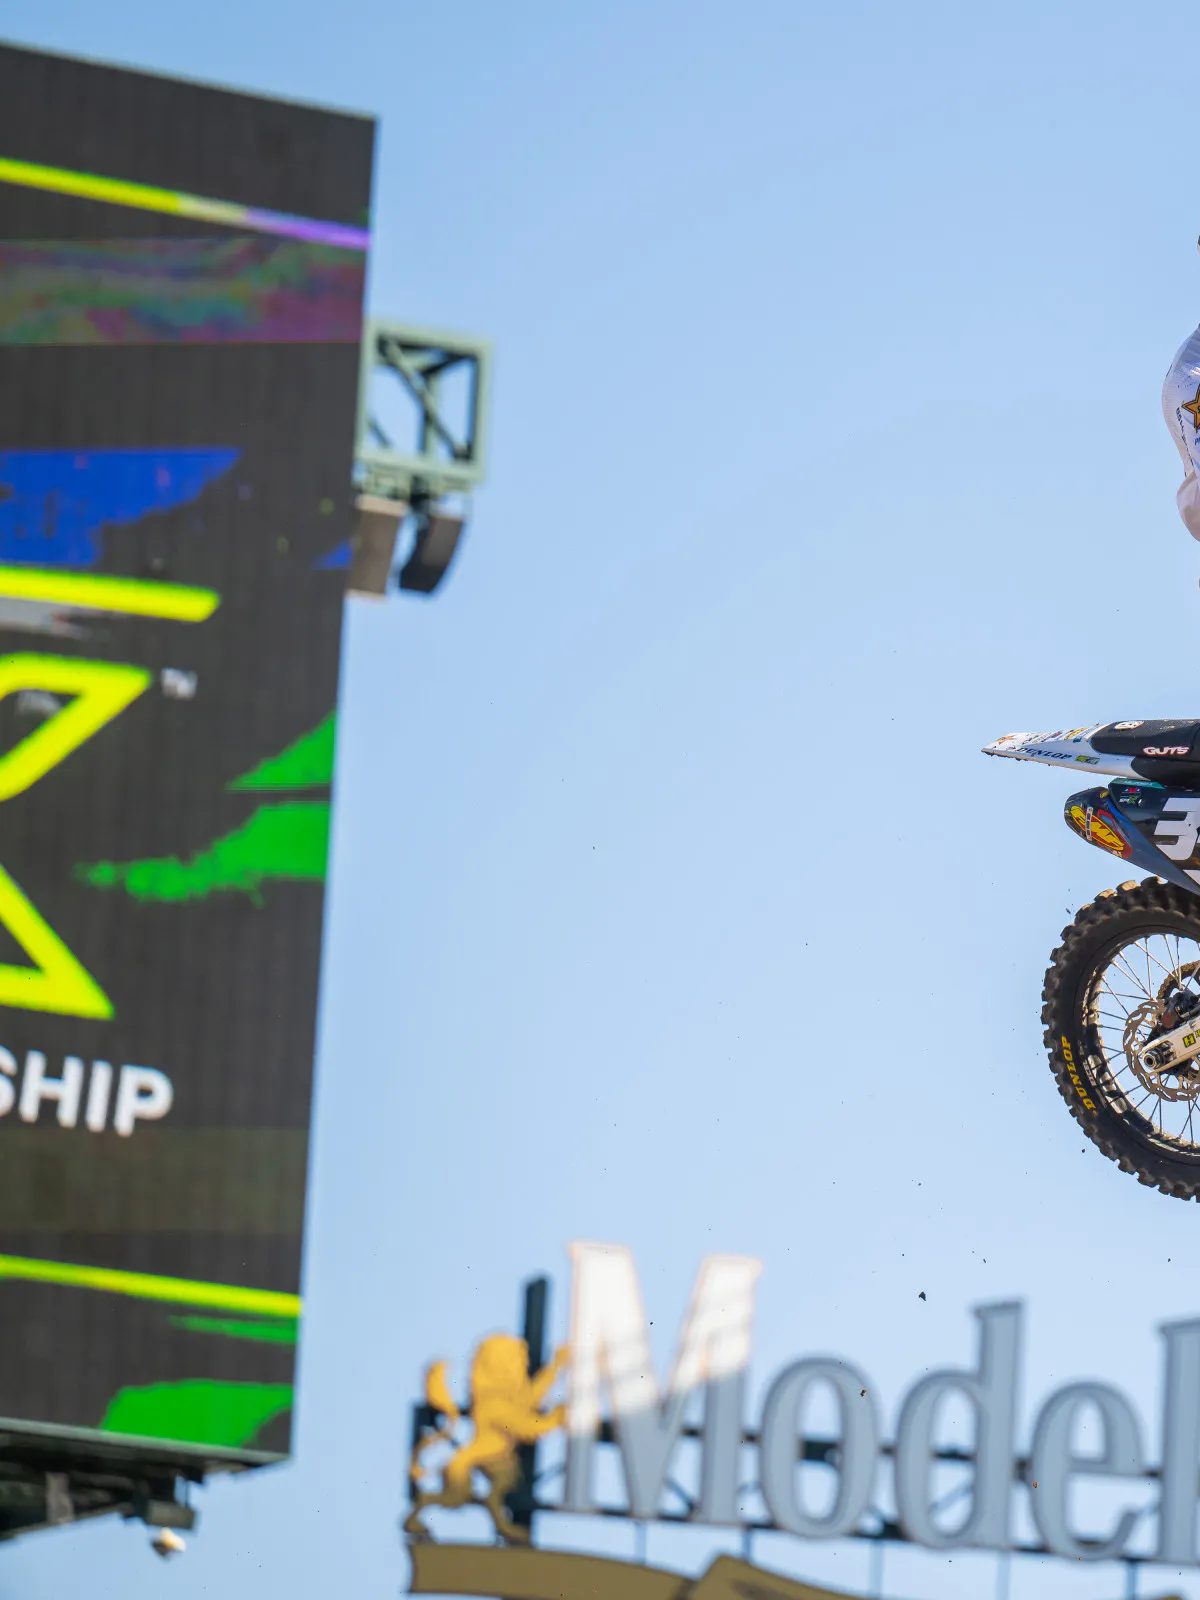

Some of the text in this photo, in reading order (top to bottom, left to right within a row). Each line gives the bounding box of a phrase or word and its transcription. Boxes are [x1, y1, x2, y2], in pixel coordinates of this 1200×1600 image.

[1016, 747, 1073, 760] DUNLOP
[1143, 746, 1190, 756] GUTS
[1061, 1035, 1096, 1111] DUNLOP
